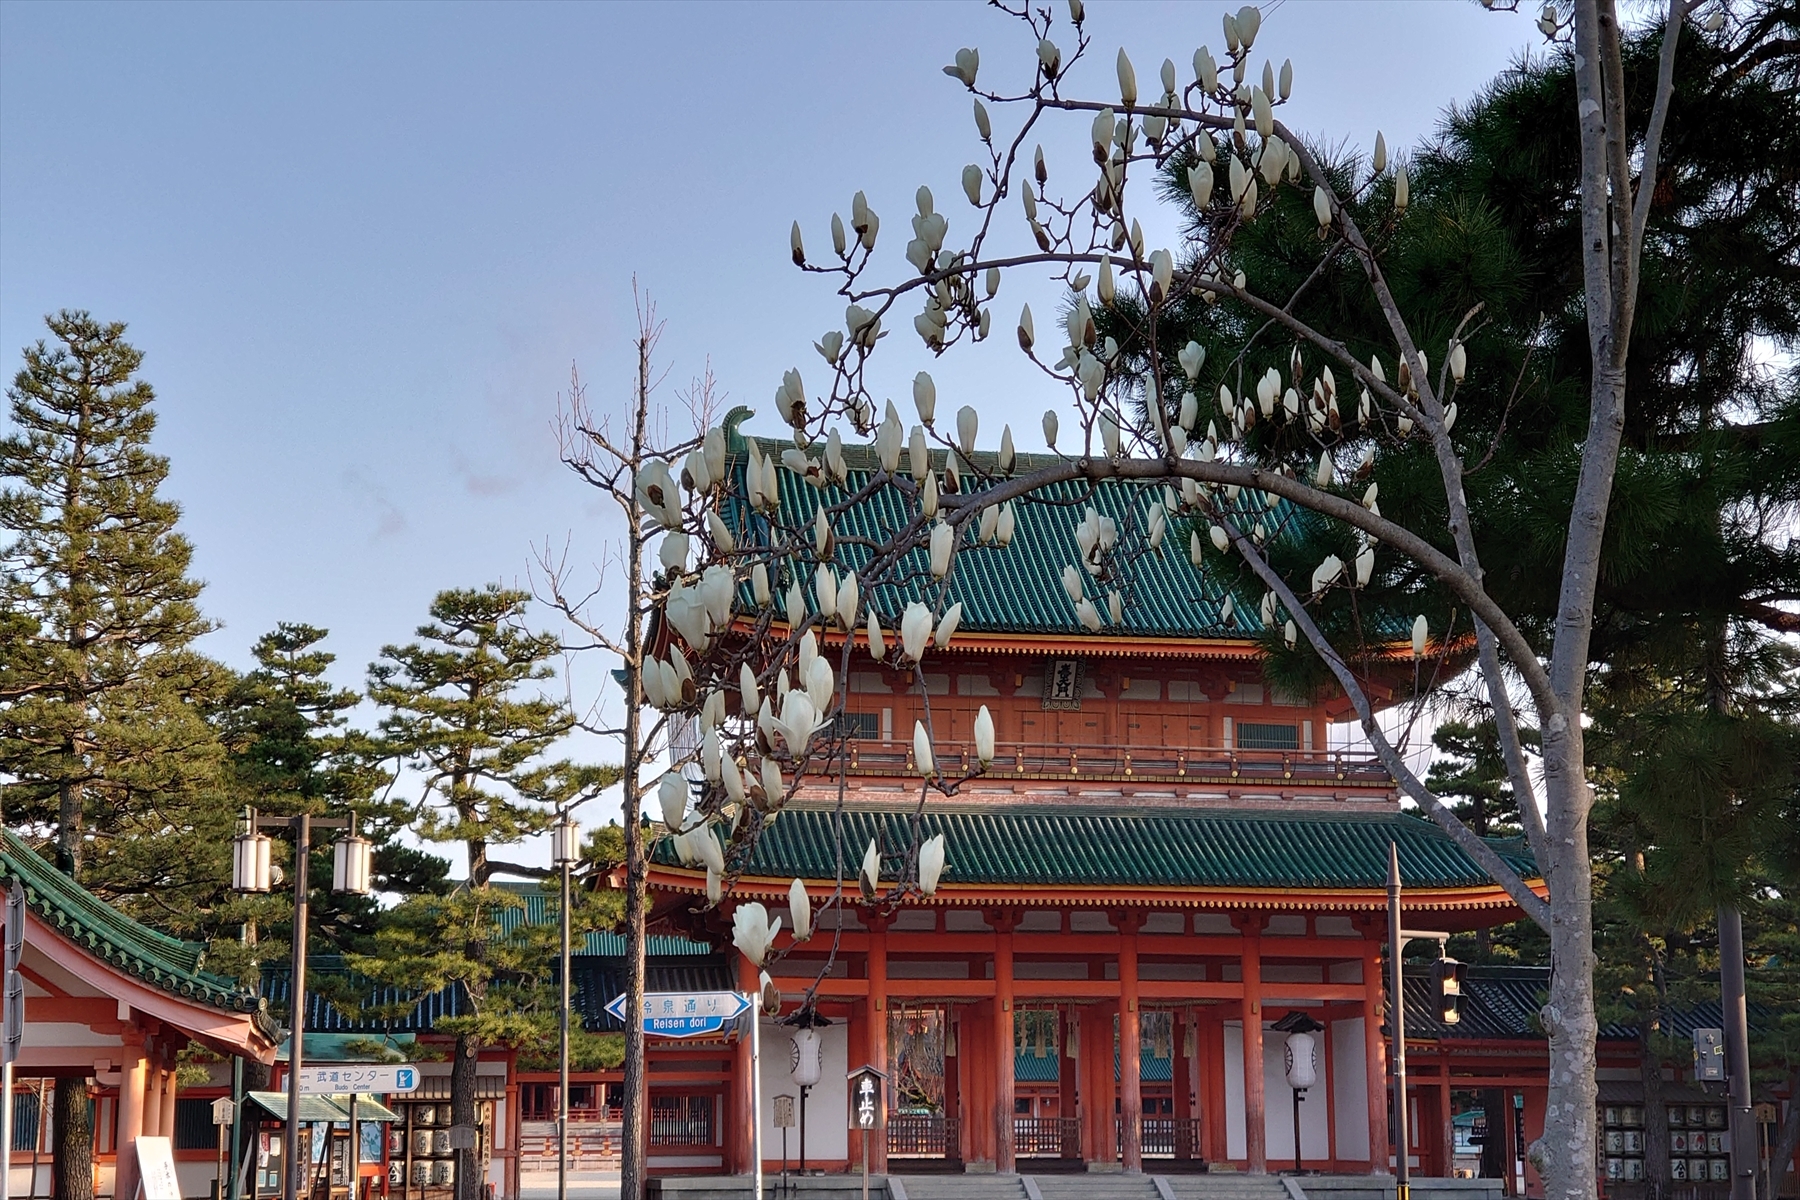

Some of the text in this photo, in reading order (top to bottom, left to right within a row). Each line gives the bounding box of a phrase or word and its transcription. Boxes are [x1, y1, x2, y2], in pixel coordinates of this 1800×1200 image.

[653, 1017, 707, 1029] Reisen dori
[316, 1070, 389, 1083] 武道センター
[334, 1083, 371, 1091] Budo Center
[859, 1078, 875, 1125] 車止め
